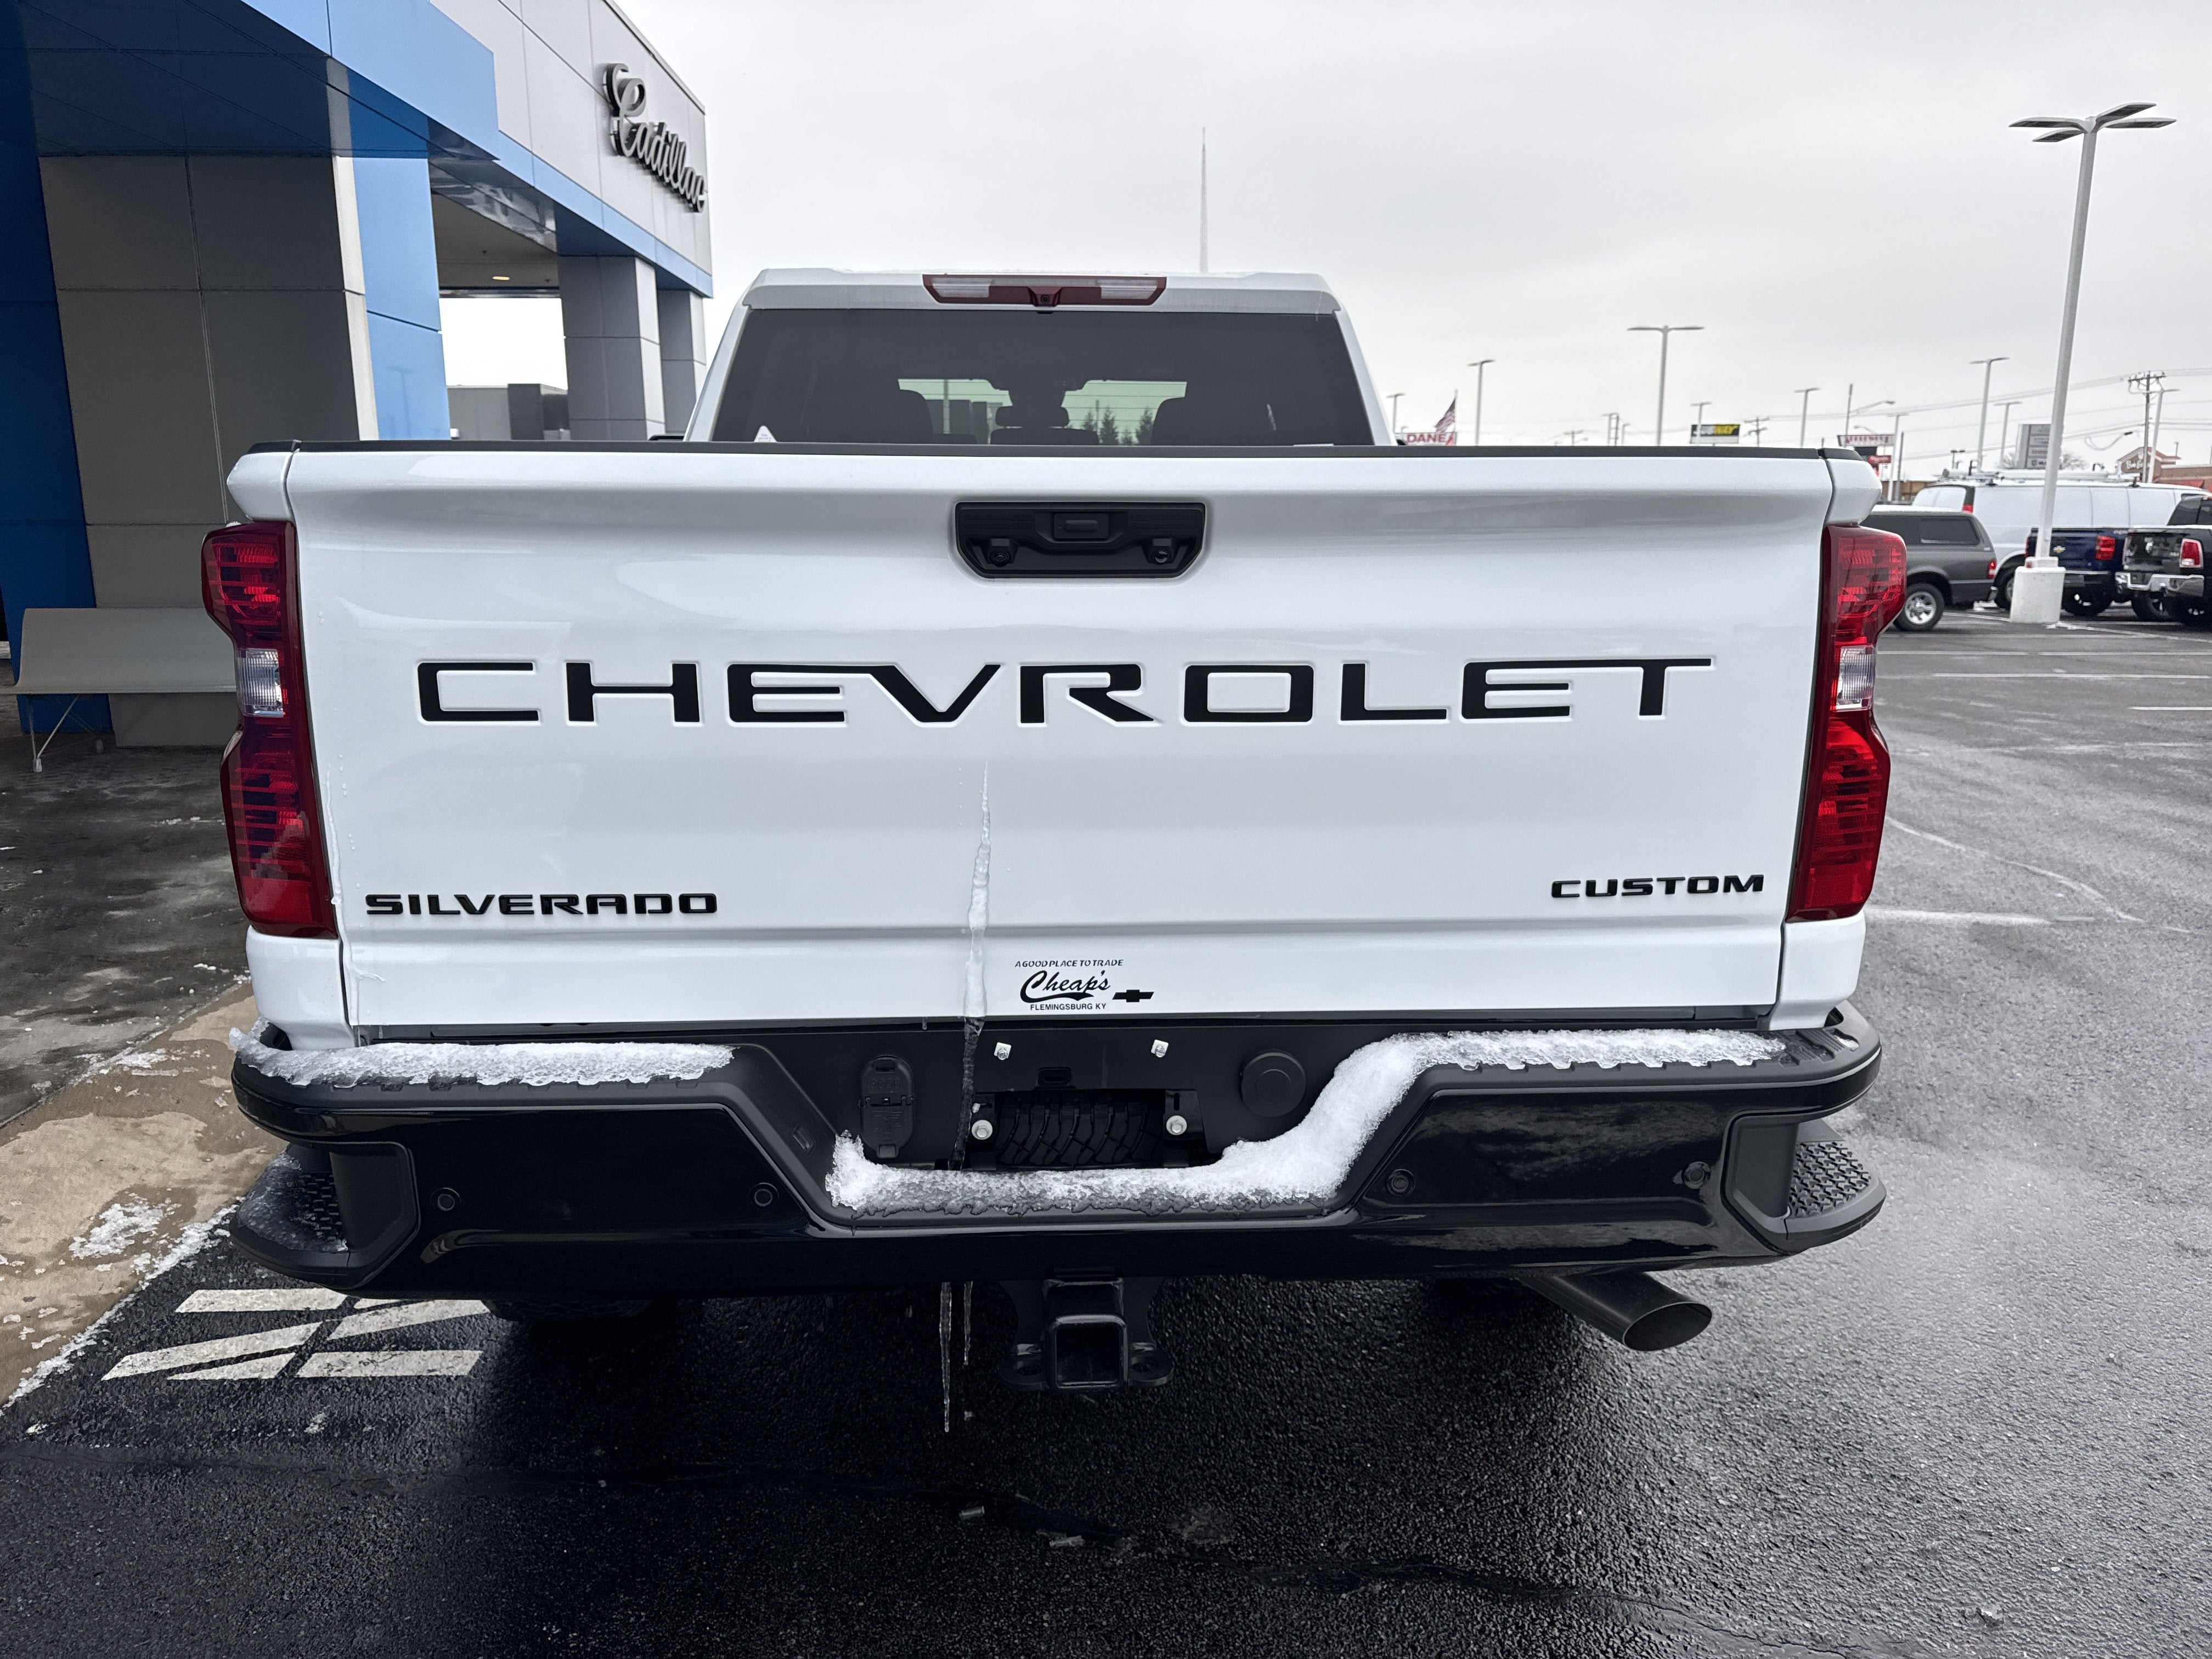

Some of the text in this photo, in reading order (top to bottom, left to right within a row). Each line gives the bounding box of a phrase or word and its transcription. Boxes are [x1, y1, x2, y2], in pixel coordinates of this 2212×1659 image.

[604, 63, 706, 212] Cadillac
[417, 658, 1712, 724] CHEVROLET
[1551, 874, 1764, 899] CUSTOM
[365, 893, 718, 916] SILVERADO
[1019, 970, 1111, 1003] Cheap's
